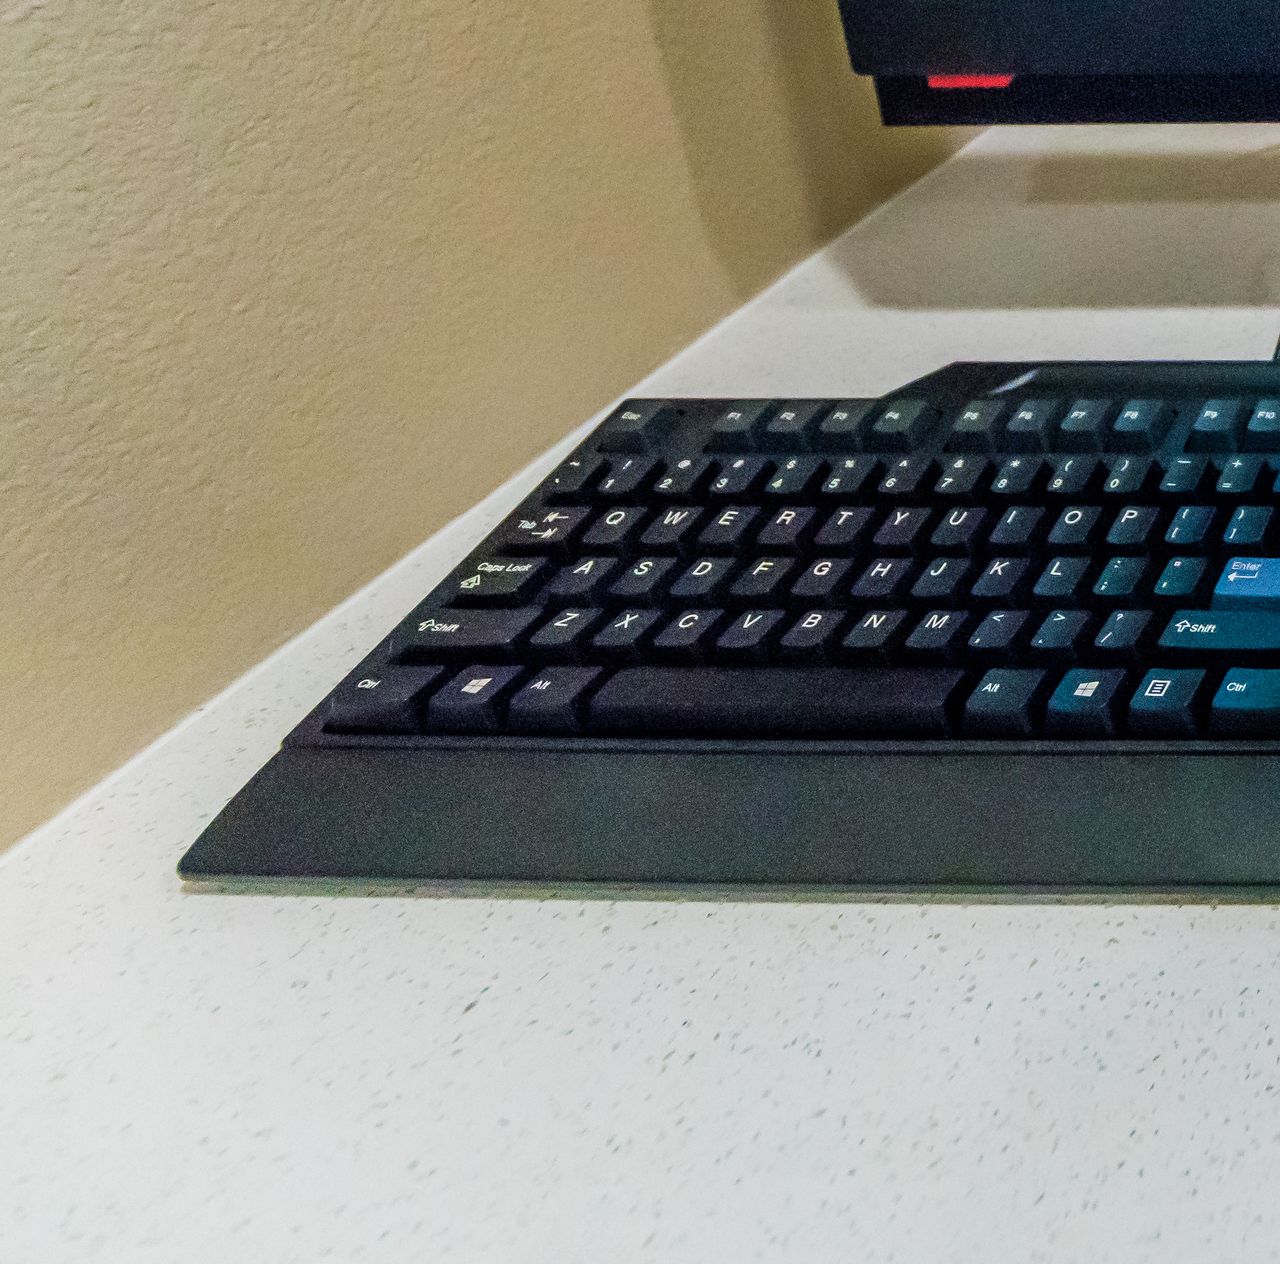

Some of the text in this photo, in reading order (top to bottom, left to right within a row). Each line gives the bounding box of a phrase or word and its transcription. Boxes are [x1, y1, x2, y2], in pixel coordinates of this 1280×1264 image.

[1070, 410, 1087, 419] F7
[1203, 409, 1219, 420] F9
[1256, 410, 1276, 420] F10
[658, 477, 673, 489] 2
[716, 477, 729, 489] 3
[771, 478, 783, 489] 4
[828, 477, 841, 489] 5
[885, 477, 897, 488] 6
[941, 477, 954, 488] 7
[997, 478, 1009, 489] 8
[1052, 477, 1064, 489] 9
[1109, 478, 1120, 489] 0
[605, 510, 626, 526] Q
[663, 510, 689, 525] W
[717, 510, 739, 526] E
[775, 510, 796, 525] R
[837, 510, 854, 526] T
[893, 511, 910, 526] Y
[948, 510, 968, 526] U
[1006, 510, 1017, 524] I
[1064, 509, 1083, 525] O
[1120, 509, 1139, 524] P
[477, 562, 532, 573] Caps Lock
[572, 560, 594, 575] A
[633, 561, 654, 576] S
[691, 561, 713, 576] D
[752, 561, 774, 576] F
[813, 561, 833, 576] G
[870, 562, 893, 577] H
[929, 561, 948, 577] J
[989, 560, 1010, 576] K
[1049, 560, 1062, 576] L
[1231, 561, 1262, 571] Enter
[553, 612, 580, 627] Z
[614, 613, 639, 629] X
[678, 613, 699, 629] C
[742, 613, 763, 629] V
[801, 613, 823, 629] B
[863, 614, 887, 629] N
[924, 614, 950, 629] M
[1189, 623, 1217, 633] Shift
[357, 678, 381, 689] Ctrl
[530, 679, 552, 690] Alt
[981, 682, 1001, 693] Alt
[1226, 681, 1247, 692] Ctrl
